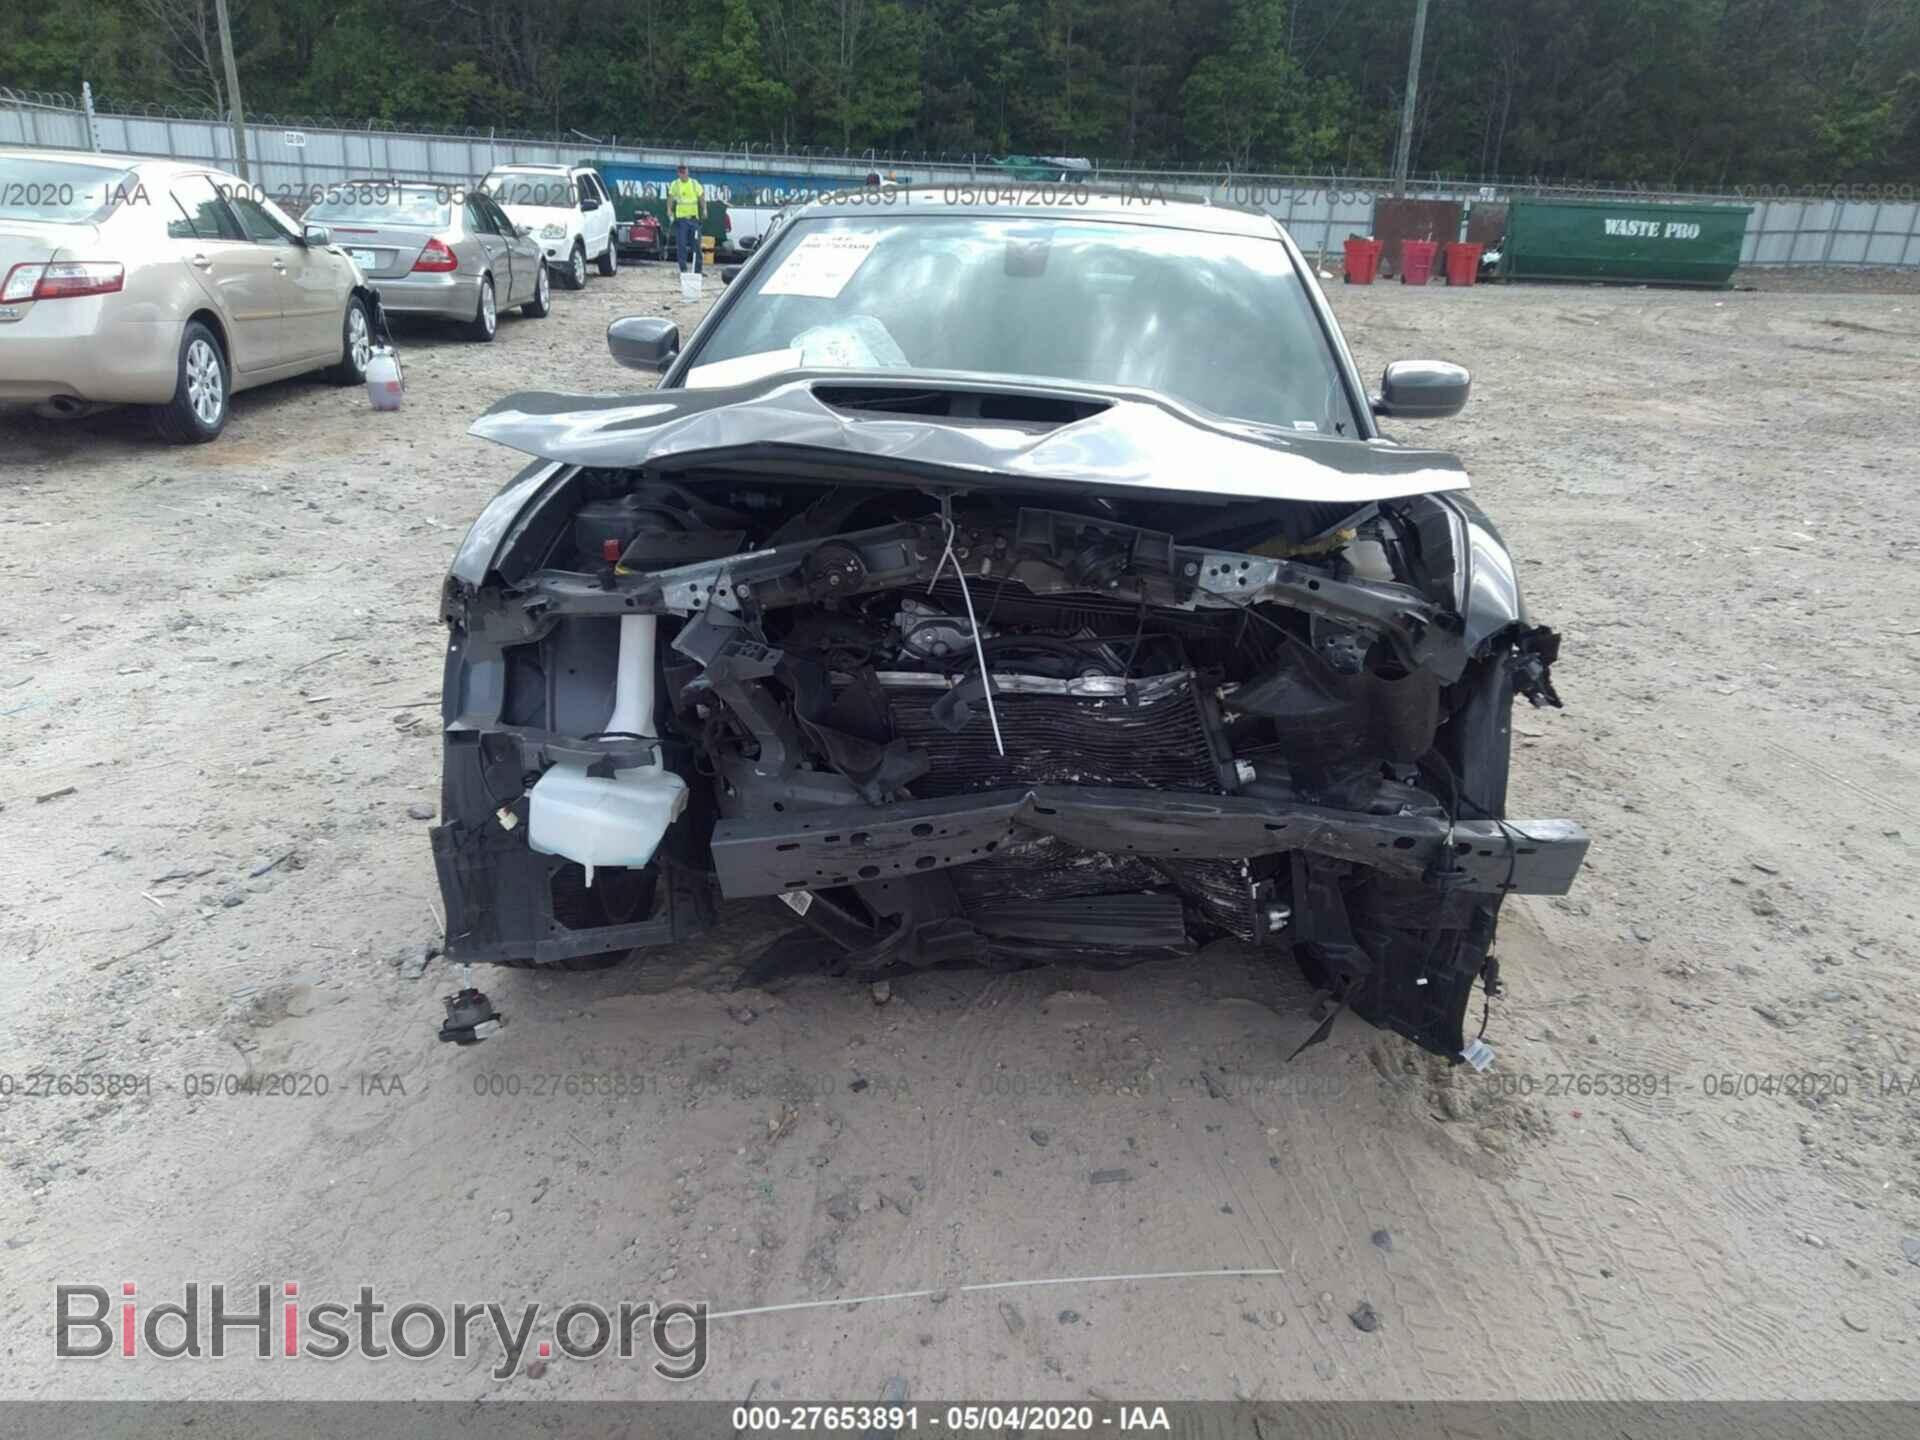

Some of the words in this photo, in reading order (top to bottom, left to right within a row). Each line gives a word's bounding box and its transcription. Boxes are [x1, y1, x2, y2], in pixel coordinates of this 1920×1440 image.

[615, 179, 672, 200] WAST
[1604, 218, 1661, 237] WASTE
[1663, 222, 1701, 239] PRO
